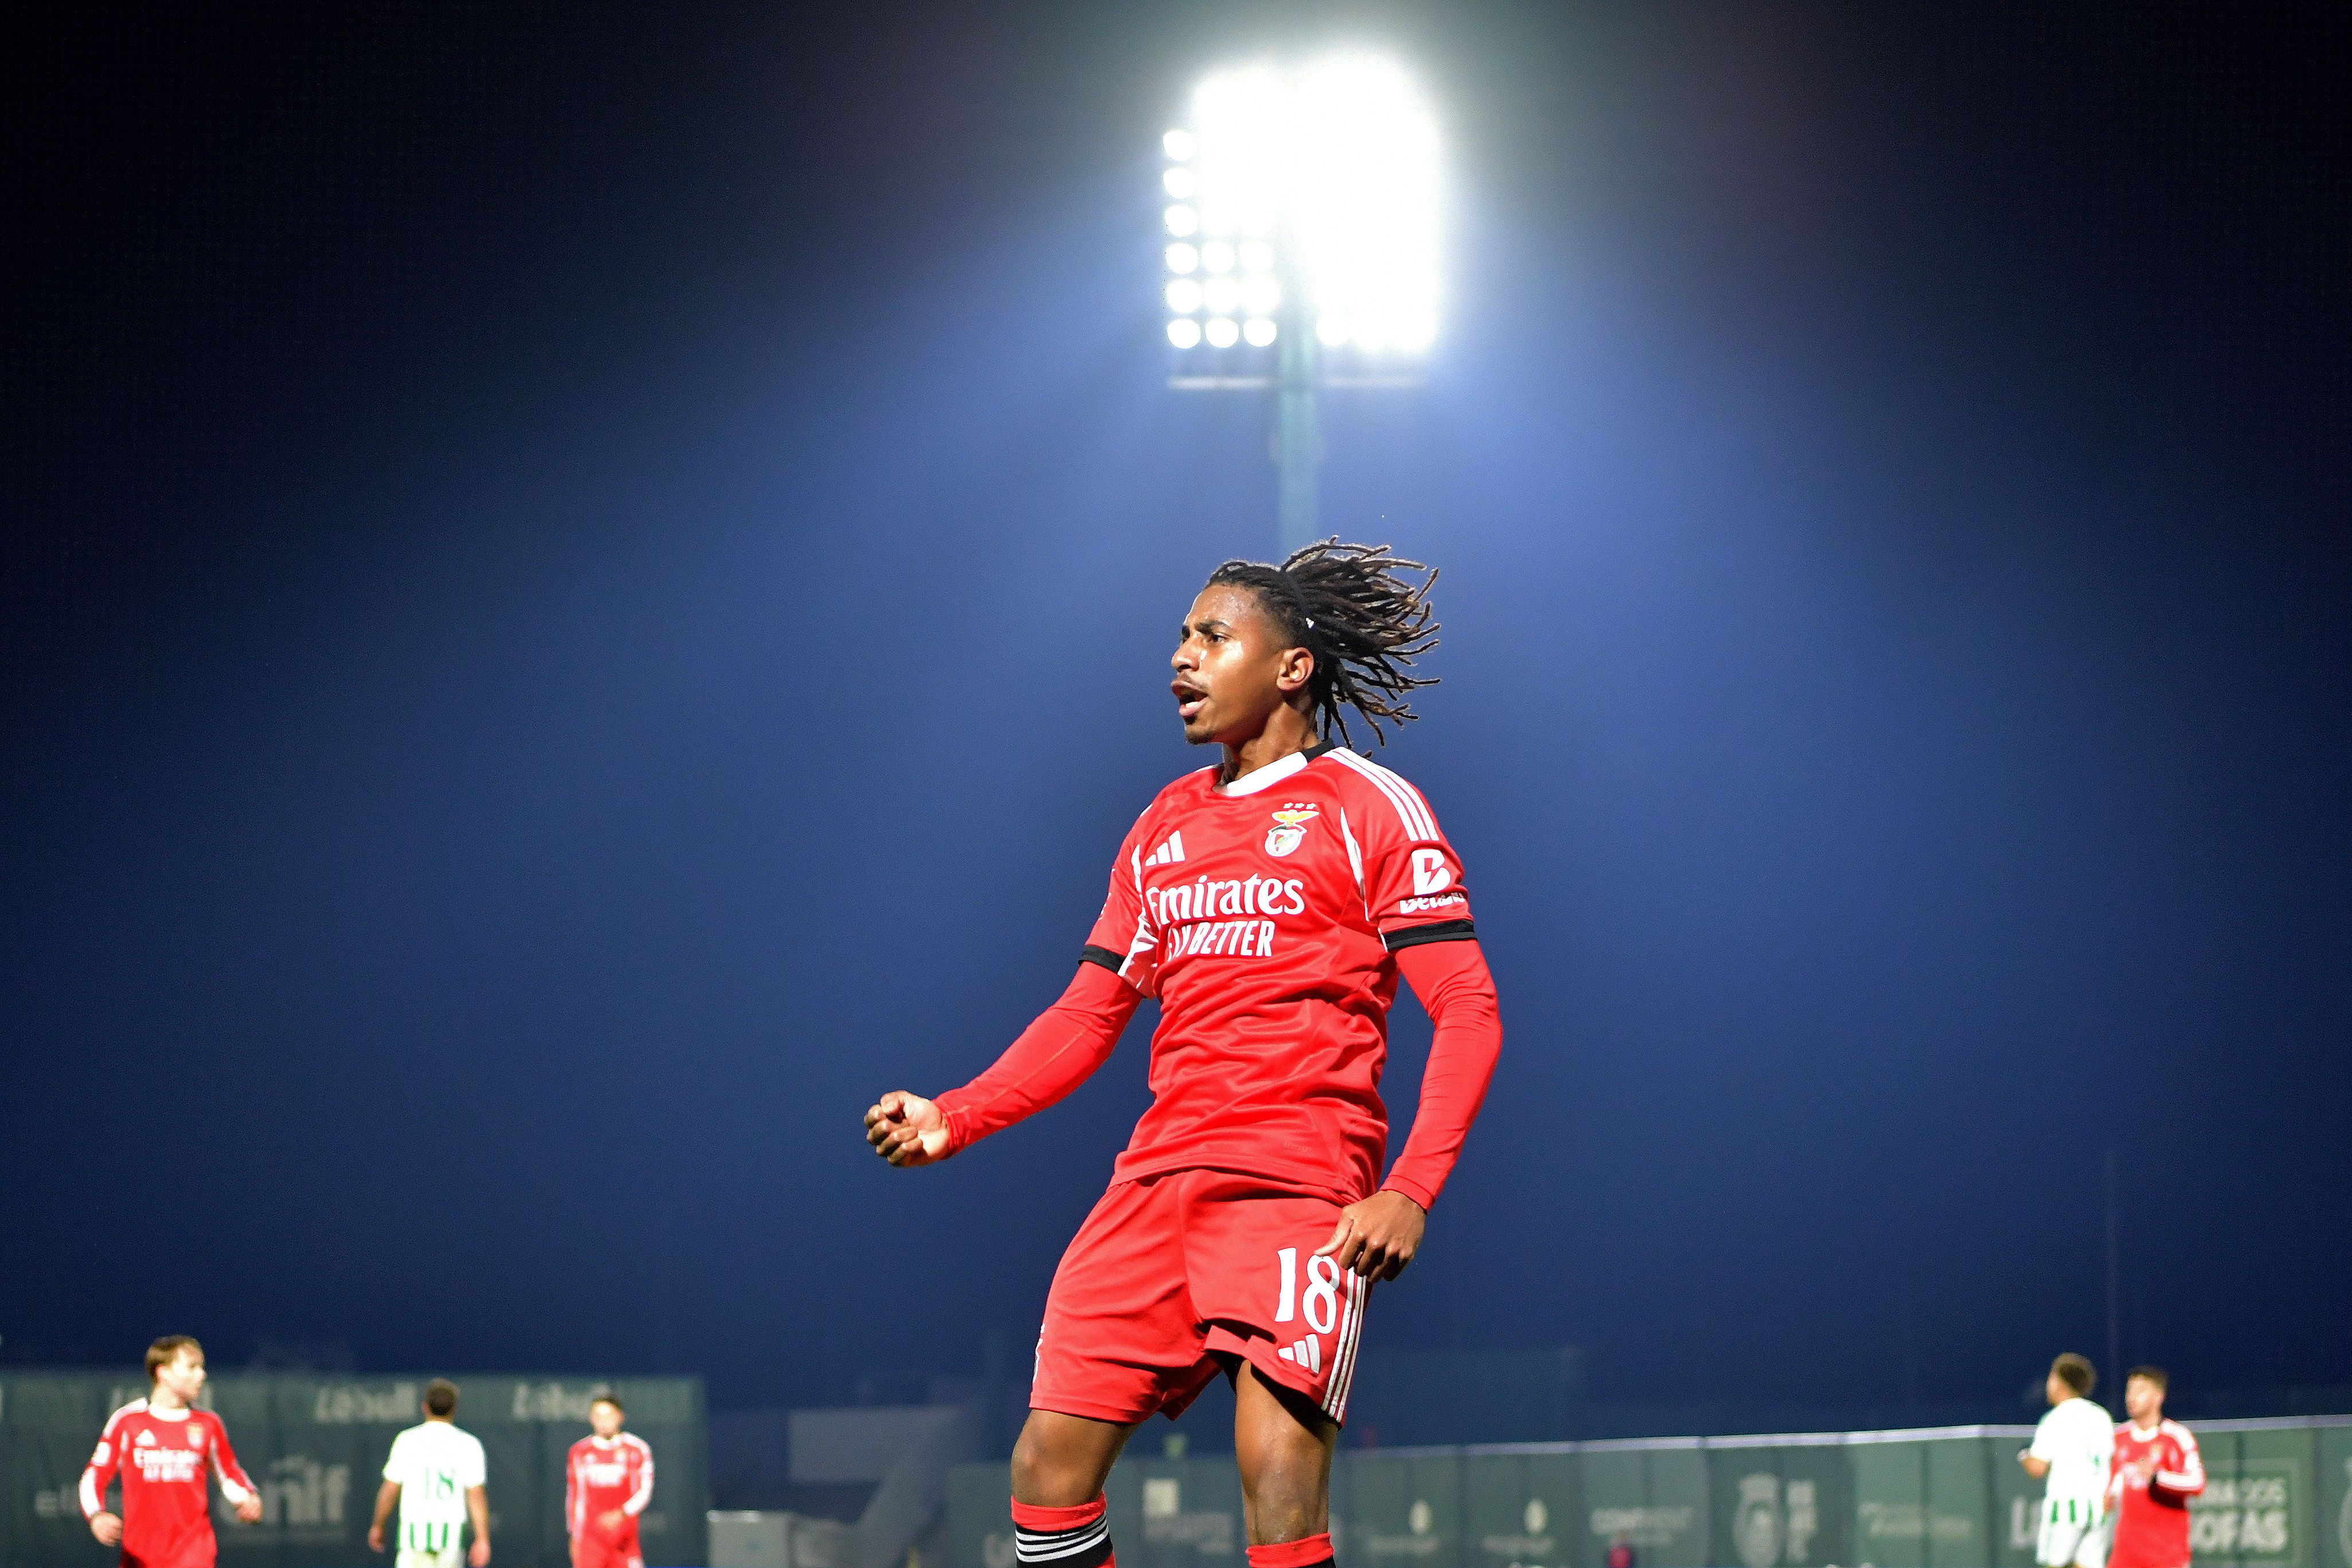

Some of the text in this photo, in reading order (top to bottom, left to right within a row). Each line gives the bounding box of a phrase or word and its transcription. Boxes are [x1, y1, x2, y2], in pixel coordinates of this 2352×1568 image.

[1146, 873, 1305, 930] Emirates
[1187, 920, 1275, 957] BETTER
[1274, 1247, 1340, 1335] 18
